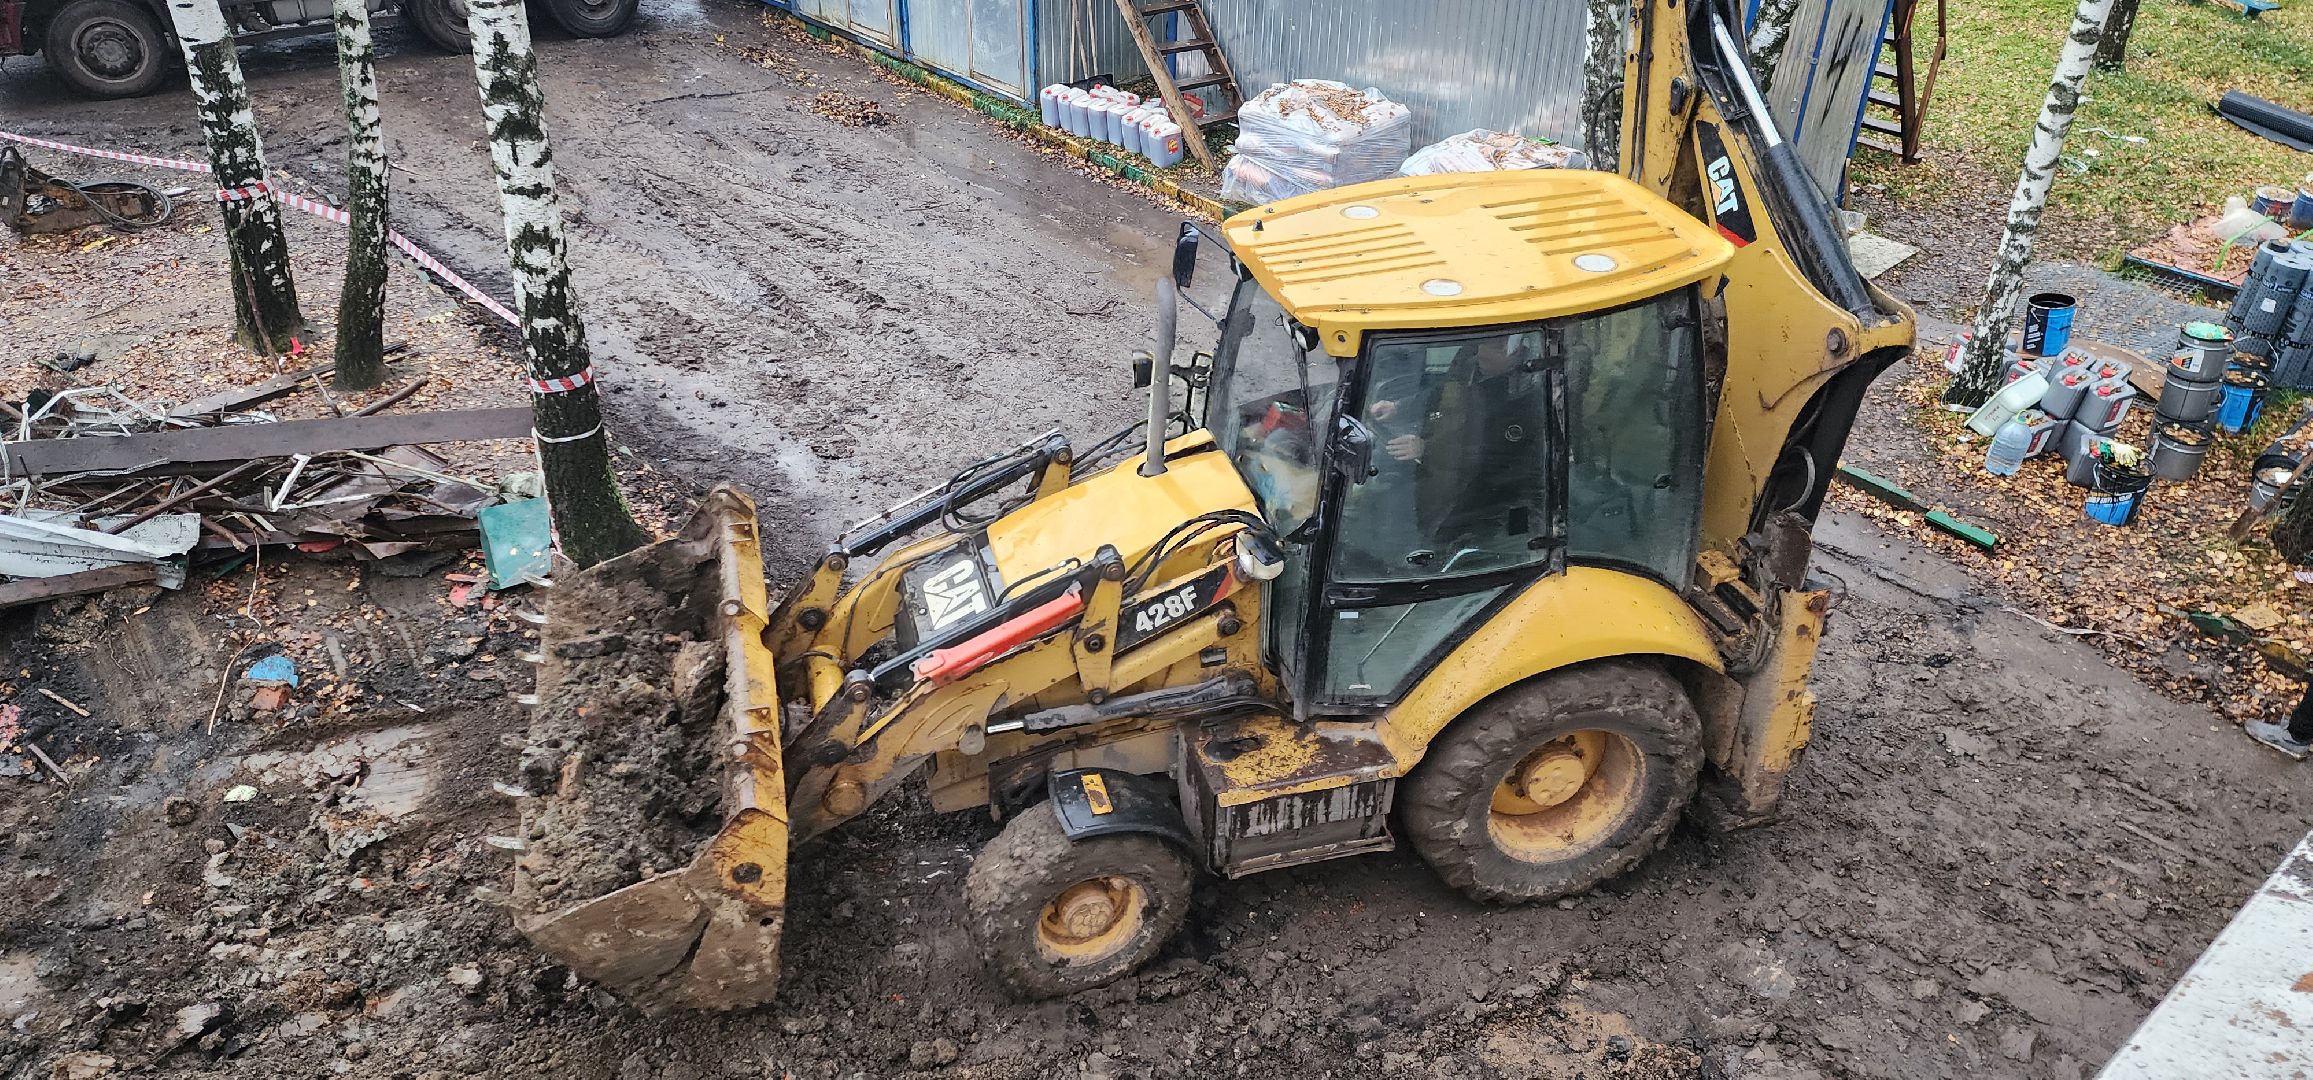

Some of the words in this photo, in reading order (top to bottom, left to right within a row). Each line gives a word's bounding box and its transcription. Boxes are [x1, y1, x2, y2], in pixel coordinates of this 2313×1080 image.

[1707, 156, 1739, 216] CAT
[923, 559, 988, 631] CAT
[1135, 585, 1198, 633] 428F
